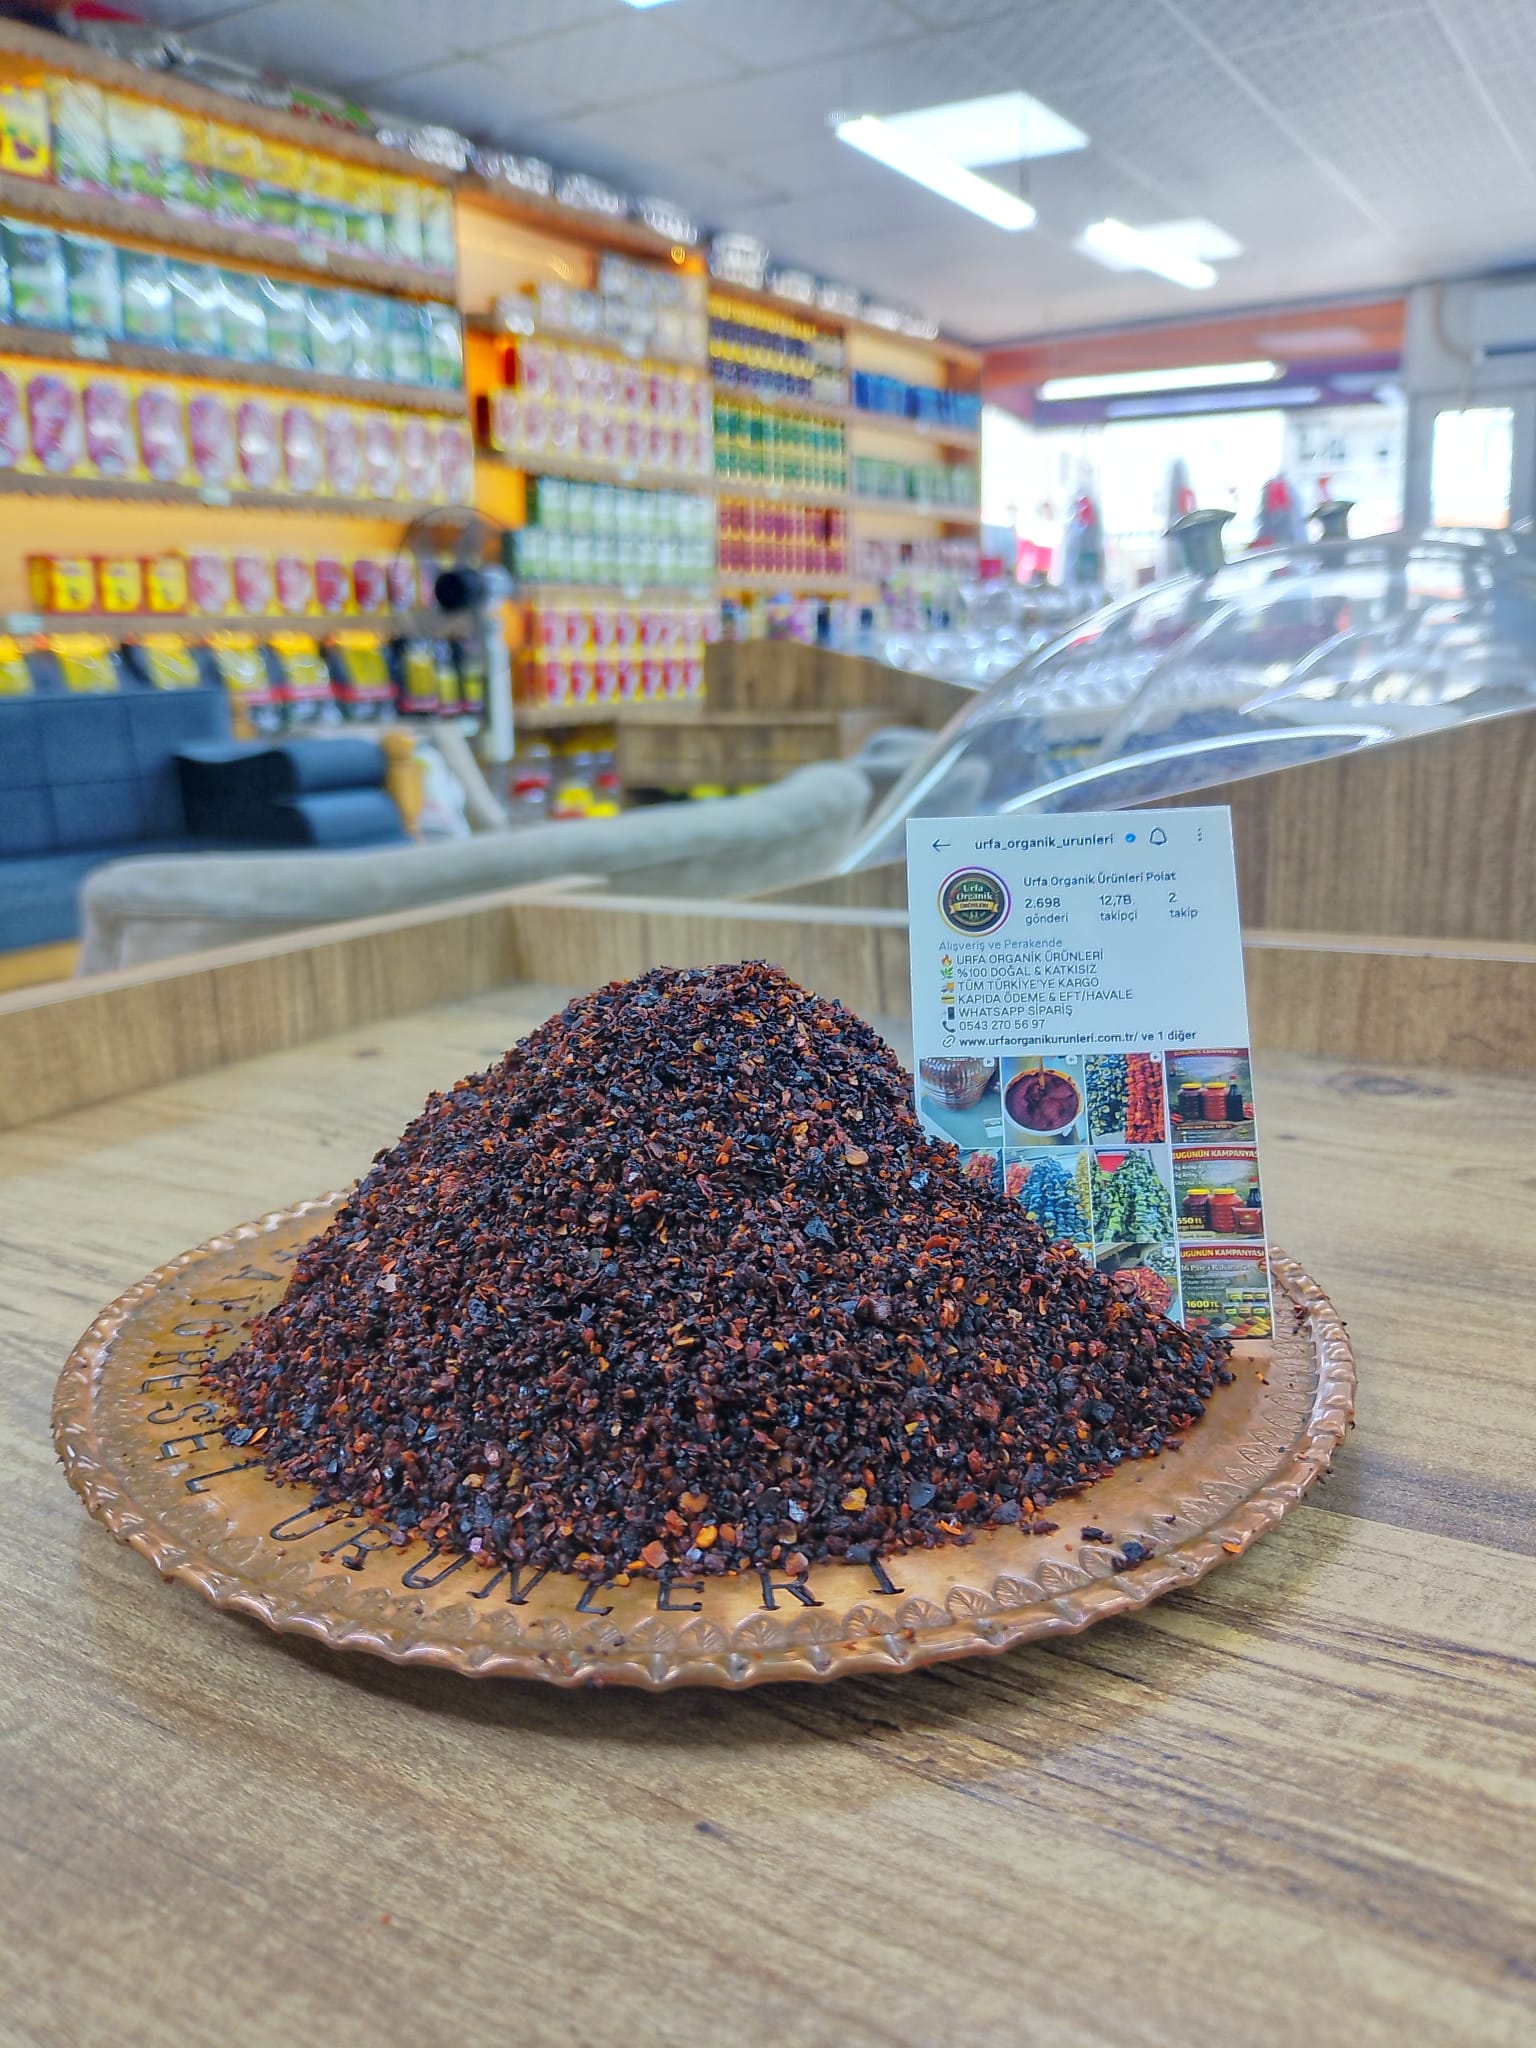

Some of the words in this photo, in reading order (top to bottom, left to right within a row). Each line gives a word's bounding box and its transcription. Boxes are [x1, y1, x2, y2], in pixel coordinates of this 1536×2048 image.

[975, 834, 1114, 851] urfa_organik_urunleri
[1023, 876, 1048, 887] Urfa
[1050, 874, 1096, 888] Organik
[1097, 872, 1144, 885] Ürünleri
[1146, 871, 1176, 882] Polat
[1025, 897, 1061, 909] 2.698
[1099, 894, 1133, 907] 12,7B
[1168, 892, 1177, 903] 2
[1025, 912, 1069, 926] gönderi
[1100, 909, 1138, 922] takipçi
[1169, 907, 1198, 919] takip
[939, 941, 985, 952] Alışveriş
[988, 941, 1000, 950] ve
[1004, 938, 1063, 950] Perakende
[956, 955, 986, 965] URFA
[989, 951, 1042, 964] ORGANİK
[1045, 949, 1104, 962] ÜRÜNLERİ
[957, 968, 987, 978] %100
[990, 965, 1031, 978] DOĞAL
[1034, 966, 1041, 976] &
[1044, 964, 1097, 976] KATKISIZ
[958, 979, 984, 991] TÜM
[1058, 977, 1099, 988] KARGO
[958, 994, 1000, 1005] KAPIDA
[1003, 991, 1045, 1003] ÖDEME
[1048, 992, 1056, 1002] &
[1059, 989, 1133, 1002] EFT/HAVALE
[959, 1006, 1025, 1018] WHATSAPP
[1028, 1003, 1073, 1017] SİPARİŞ
[959, 1021, 988, 1031] 0543
[991, 1020, 1011, 1030] 270
[1014, 1019, 1030, 1029] 56
[1031, 1019, 1045, 1029] 97
[959, 1031, 1138, 1047] www.urfaorganikurunleri.com.tr/
[1141, 1033, 1154, 1041] ve
[1157, 1031, 1163, 1040] 1
[1167, 1030, 1198, 1042] diğer
[1186, 1300, 1210, 1308] 1600
